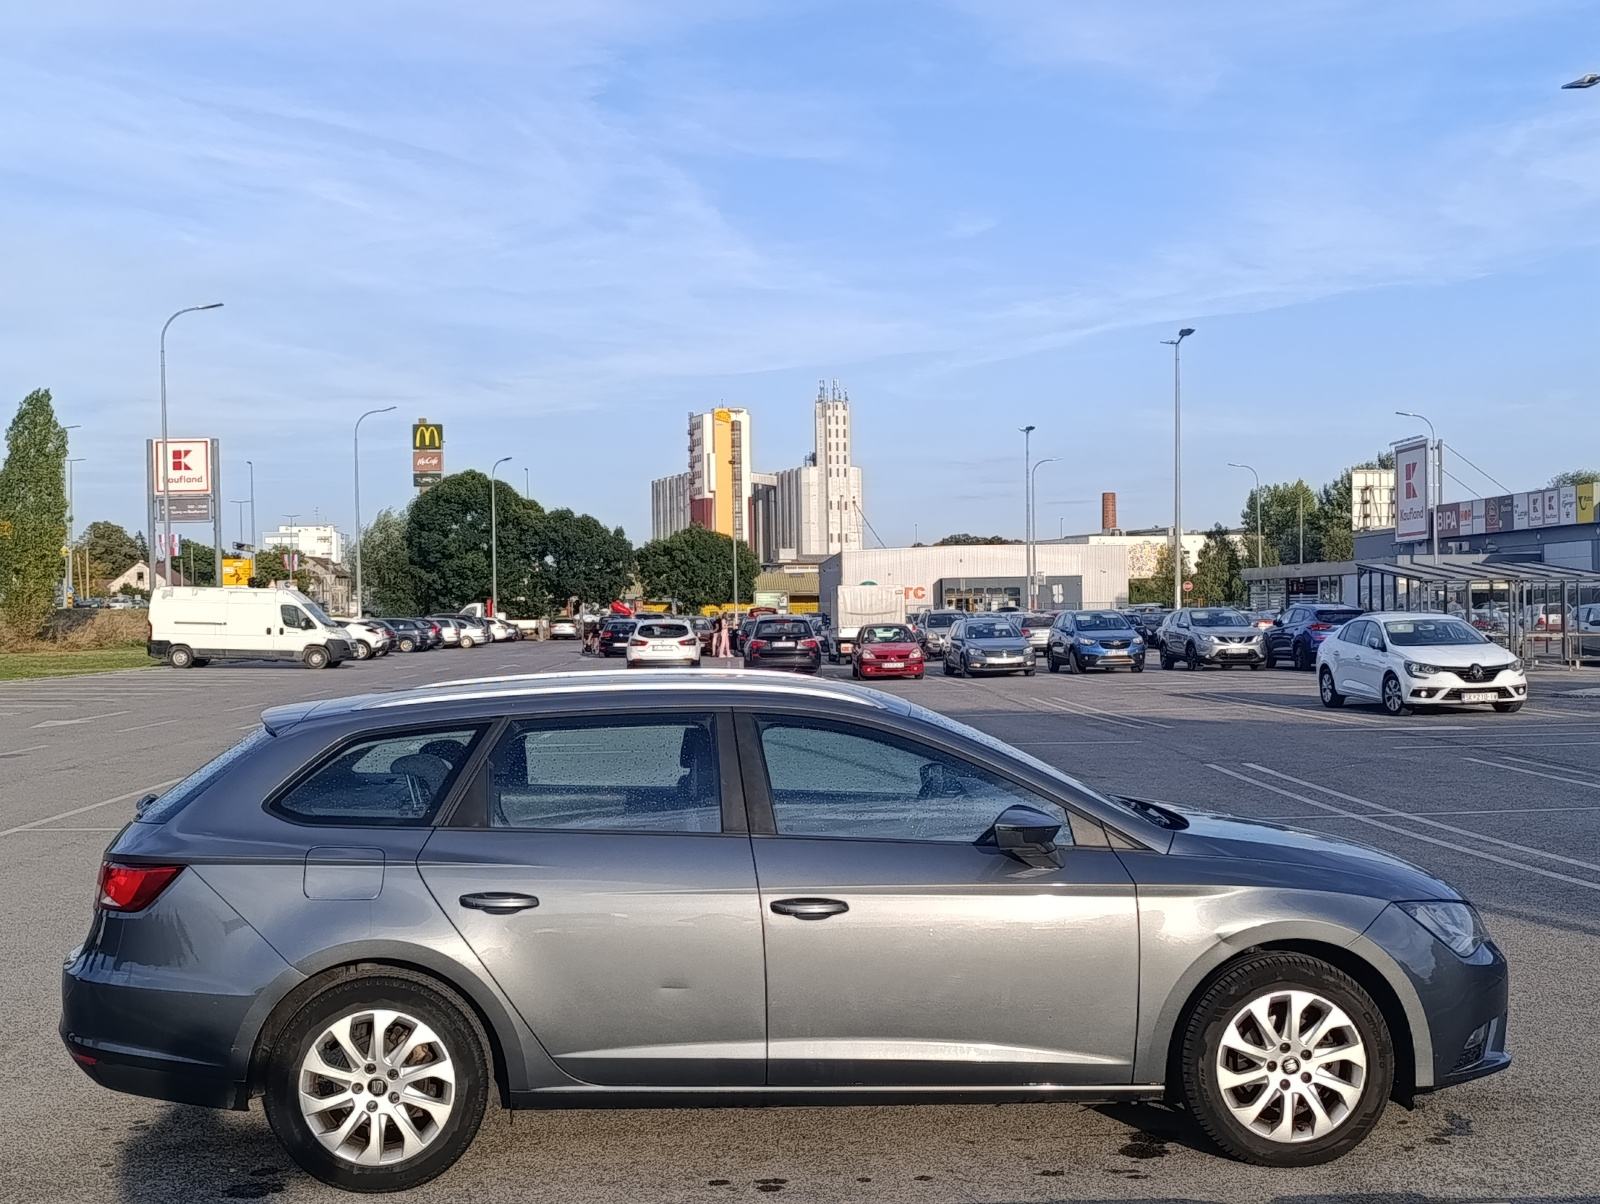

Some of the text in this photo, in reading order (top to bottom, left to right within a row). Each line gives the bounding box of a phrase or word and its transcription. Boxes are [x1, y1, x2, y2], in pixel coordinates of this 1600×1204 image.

[163, 475, 203, 484] aufland
[1400, 506, 1424, 521] Kaufland
[1437, 511, 1457, 532] BIPA
